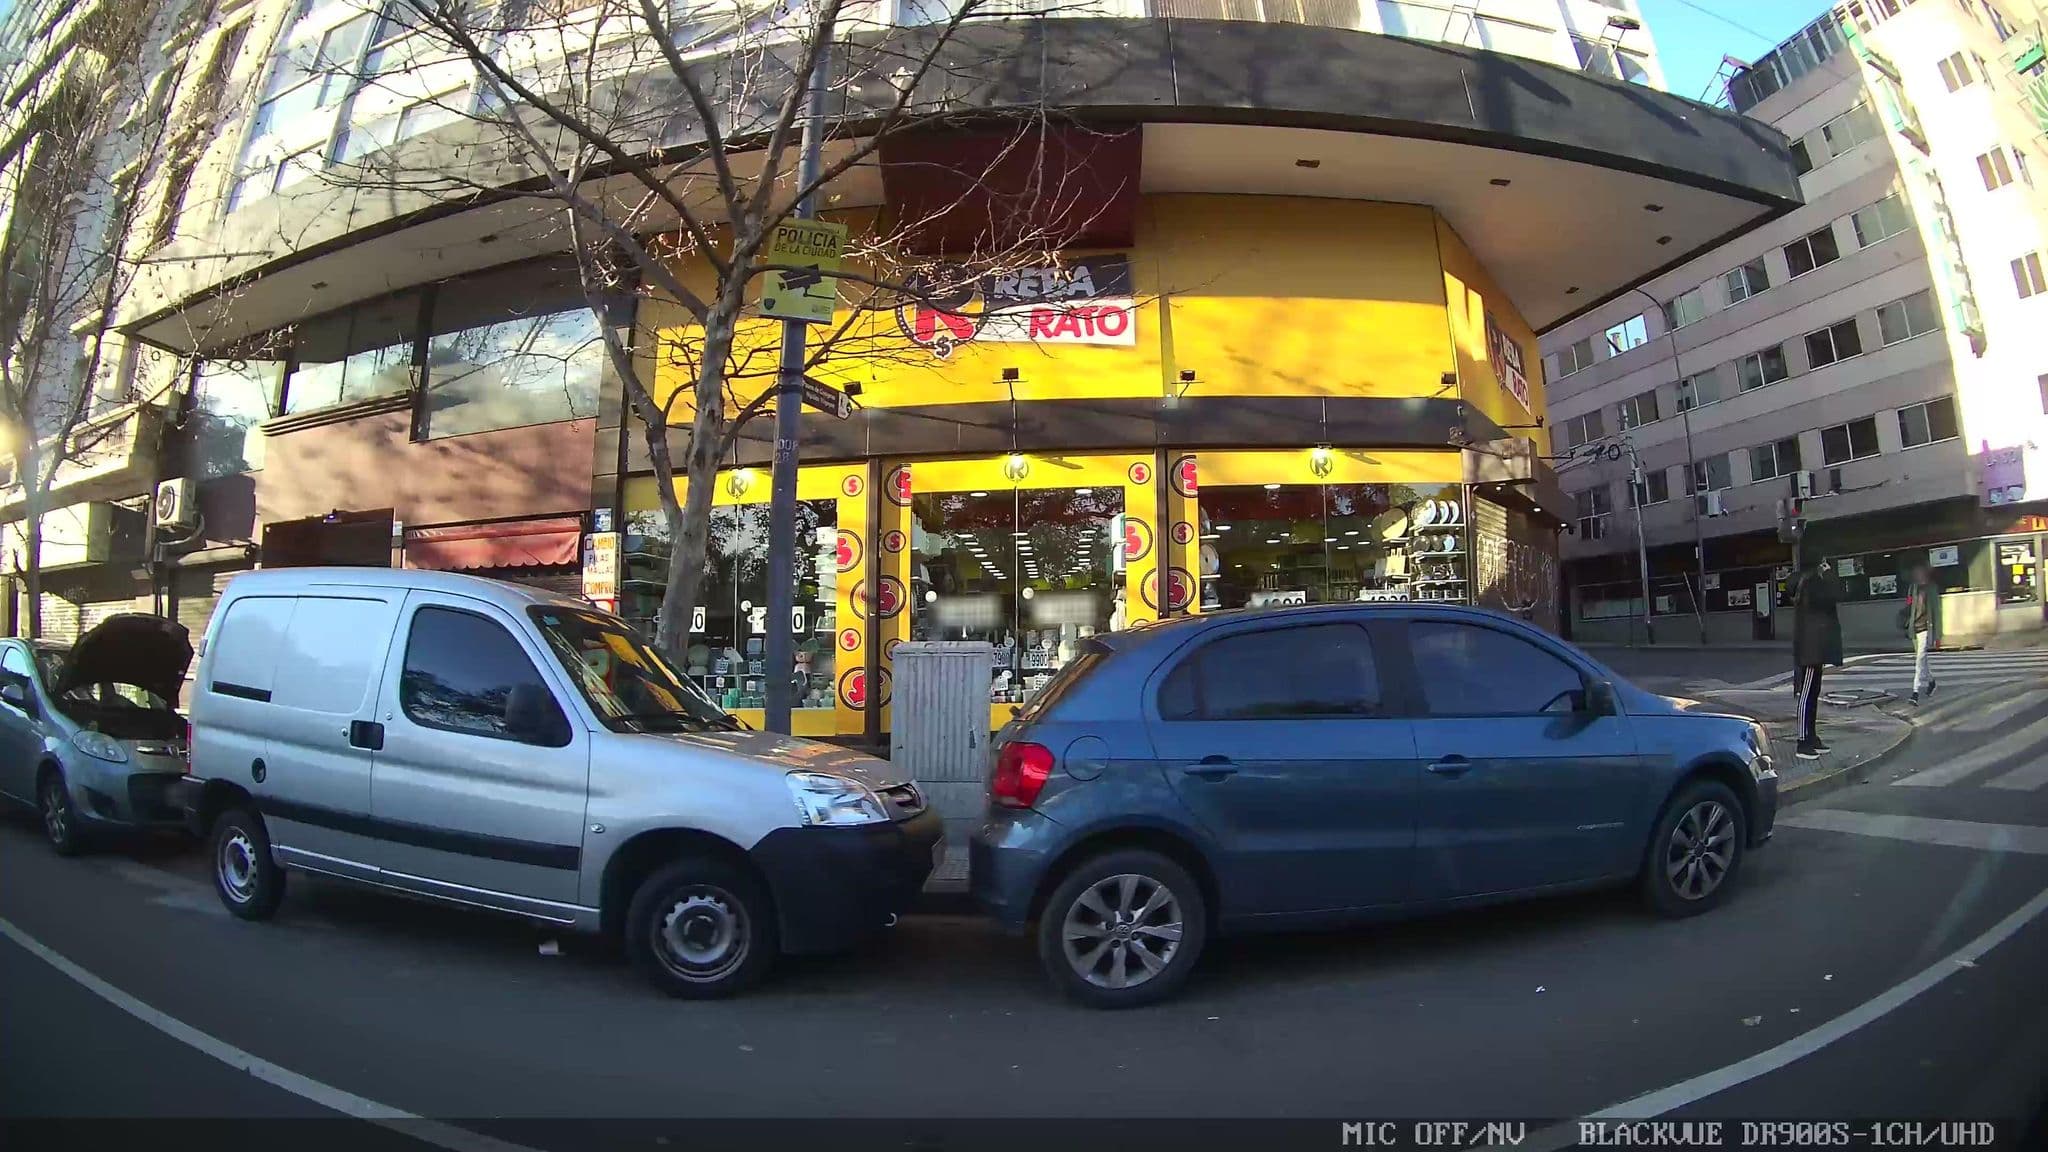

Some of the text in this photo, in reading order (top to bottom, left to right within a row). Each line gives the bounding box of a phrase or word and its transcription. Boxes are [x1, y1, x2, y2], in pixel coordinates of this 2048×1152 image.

[777, 228, 837, 249] POLICIA
[774, 243, 836, 258] DE LA CIUDAD
[1029, 305, 1128, 338] RATO
